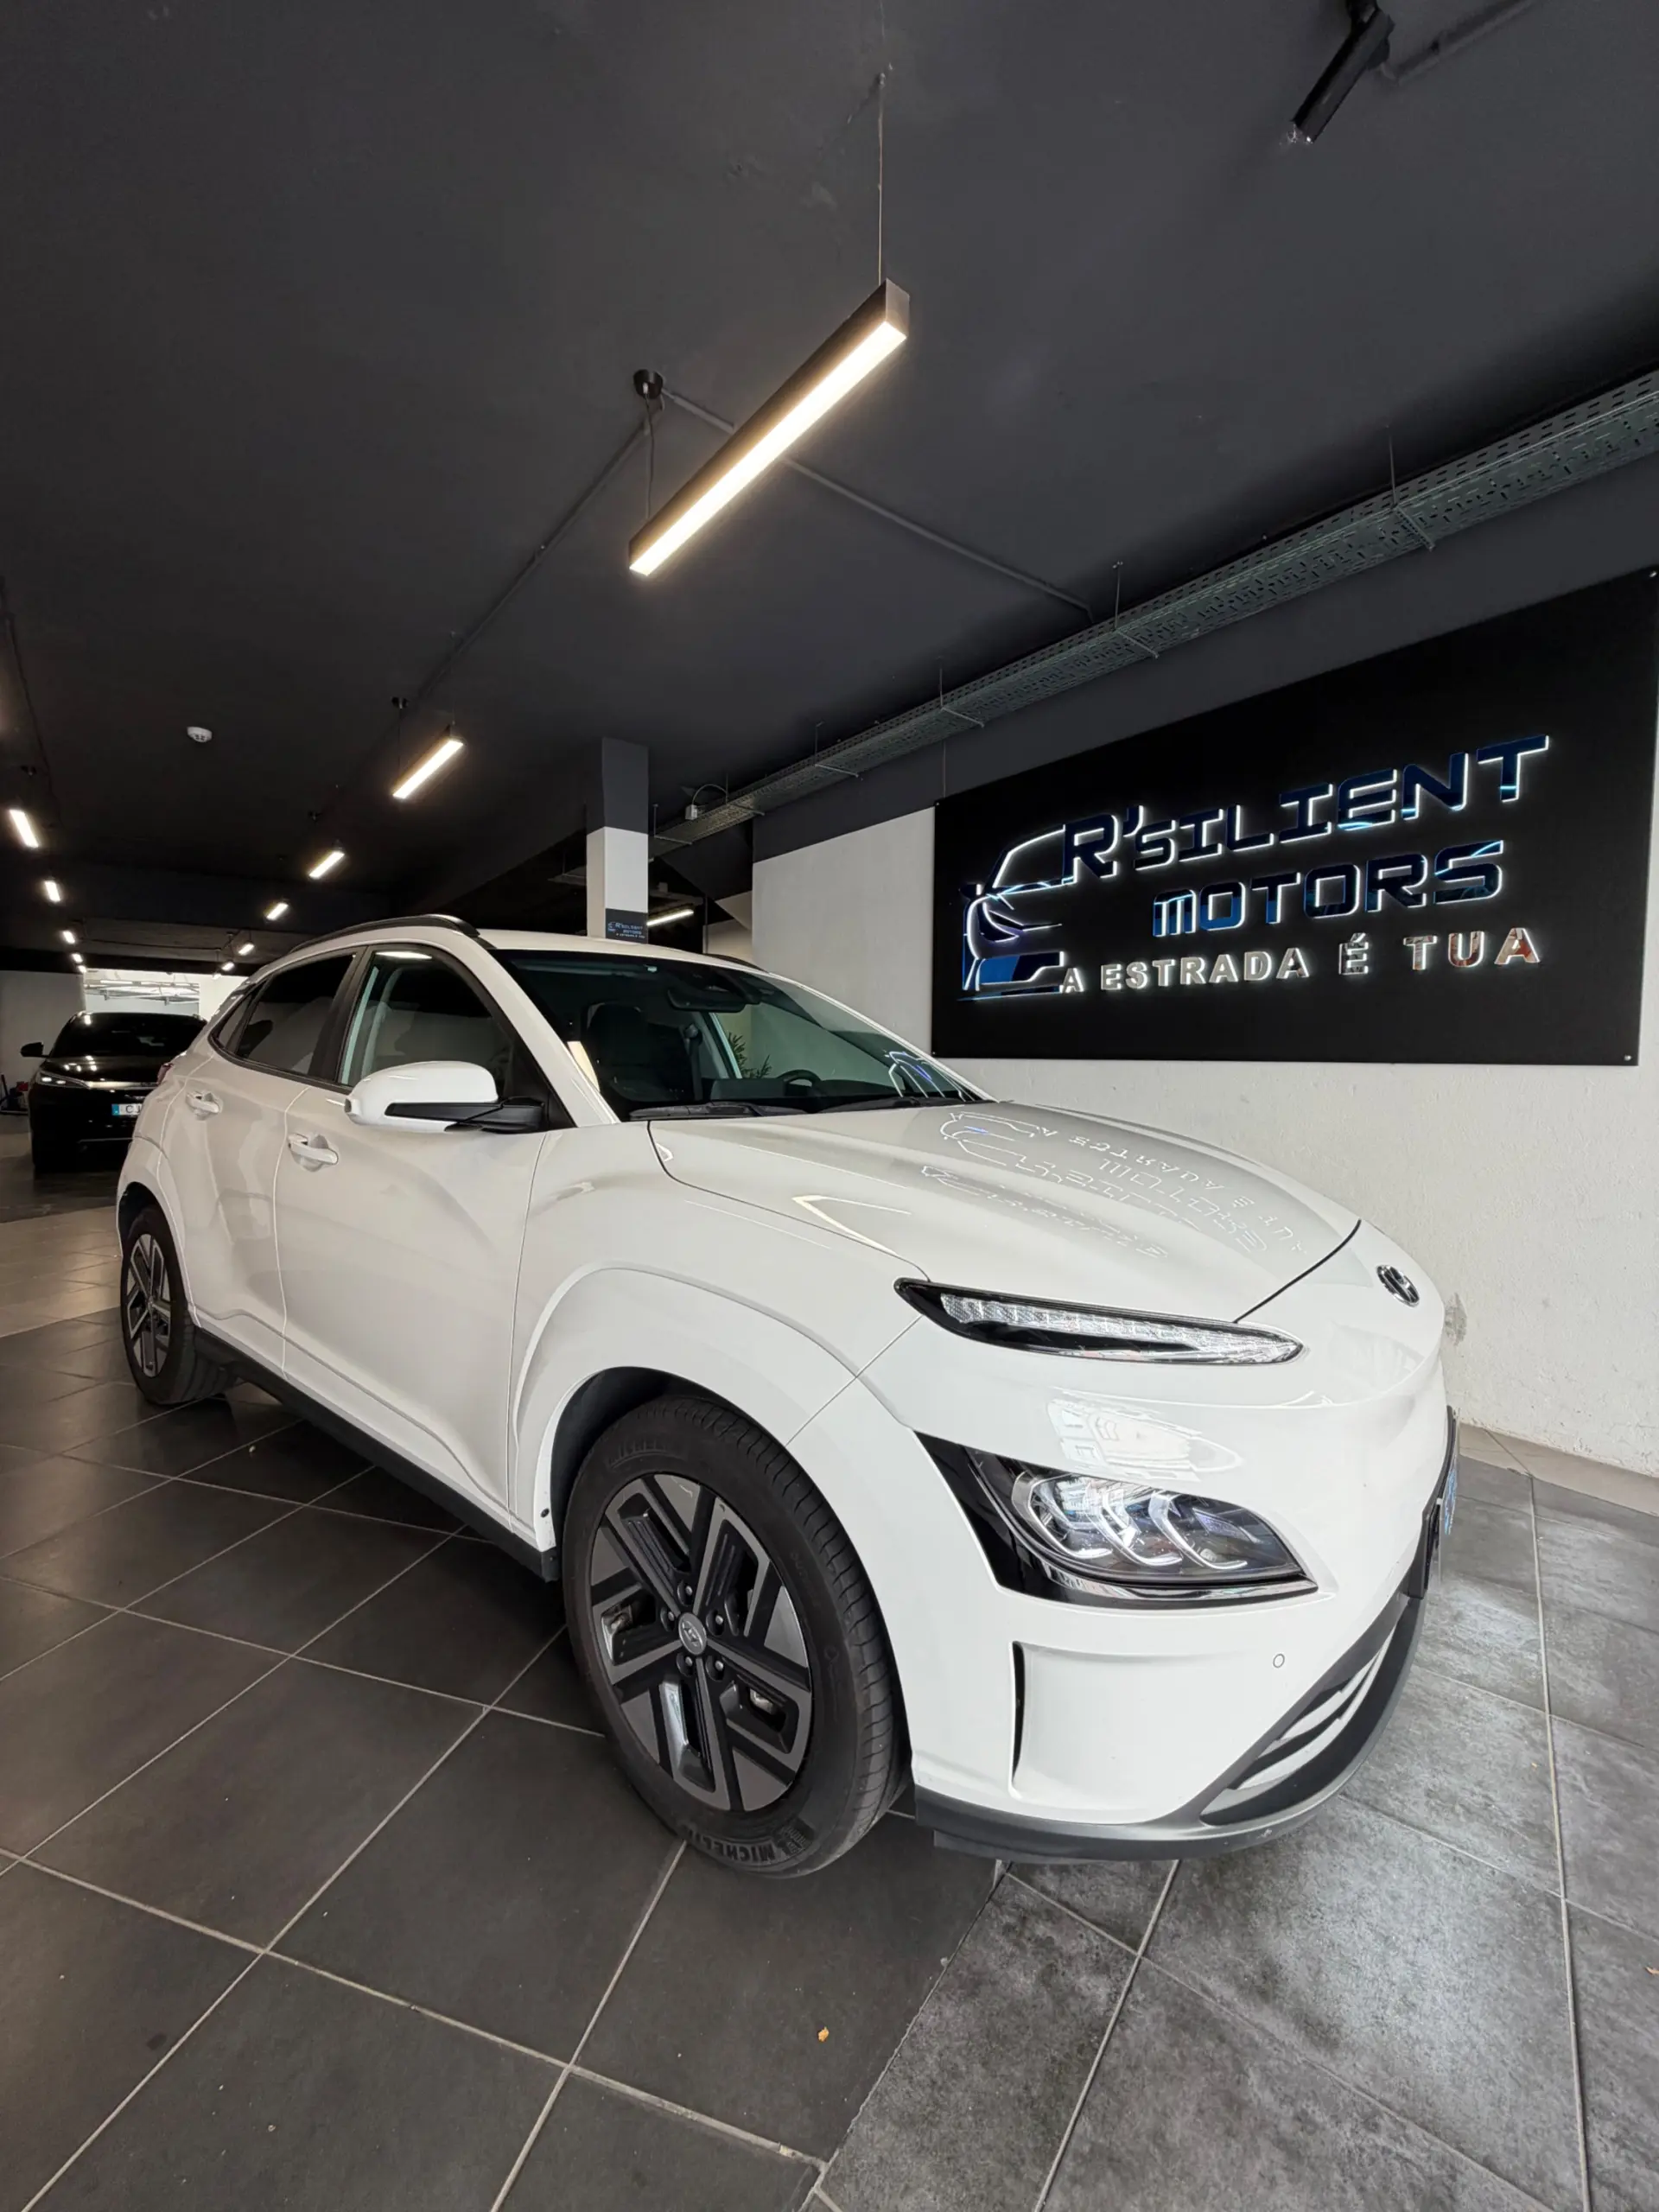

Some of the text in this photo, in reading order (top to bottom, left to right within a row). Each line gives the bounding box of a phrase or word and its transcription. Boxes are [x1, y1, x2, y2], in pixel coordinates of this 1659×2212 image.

[1061, 734, 1549, 885] R'SILIENT
[1152, 840, 1504, 938] MOTORS
[1059, 926, 1541, 994] A ESTRADA É TUA
